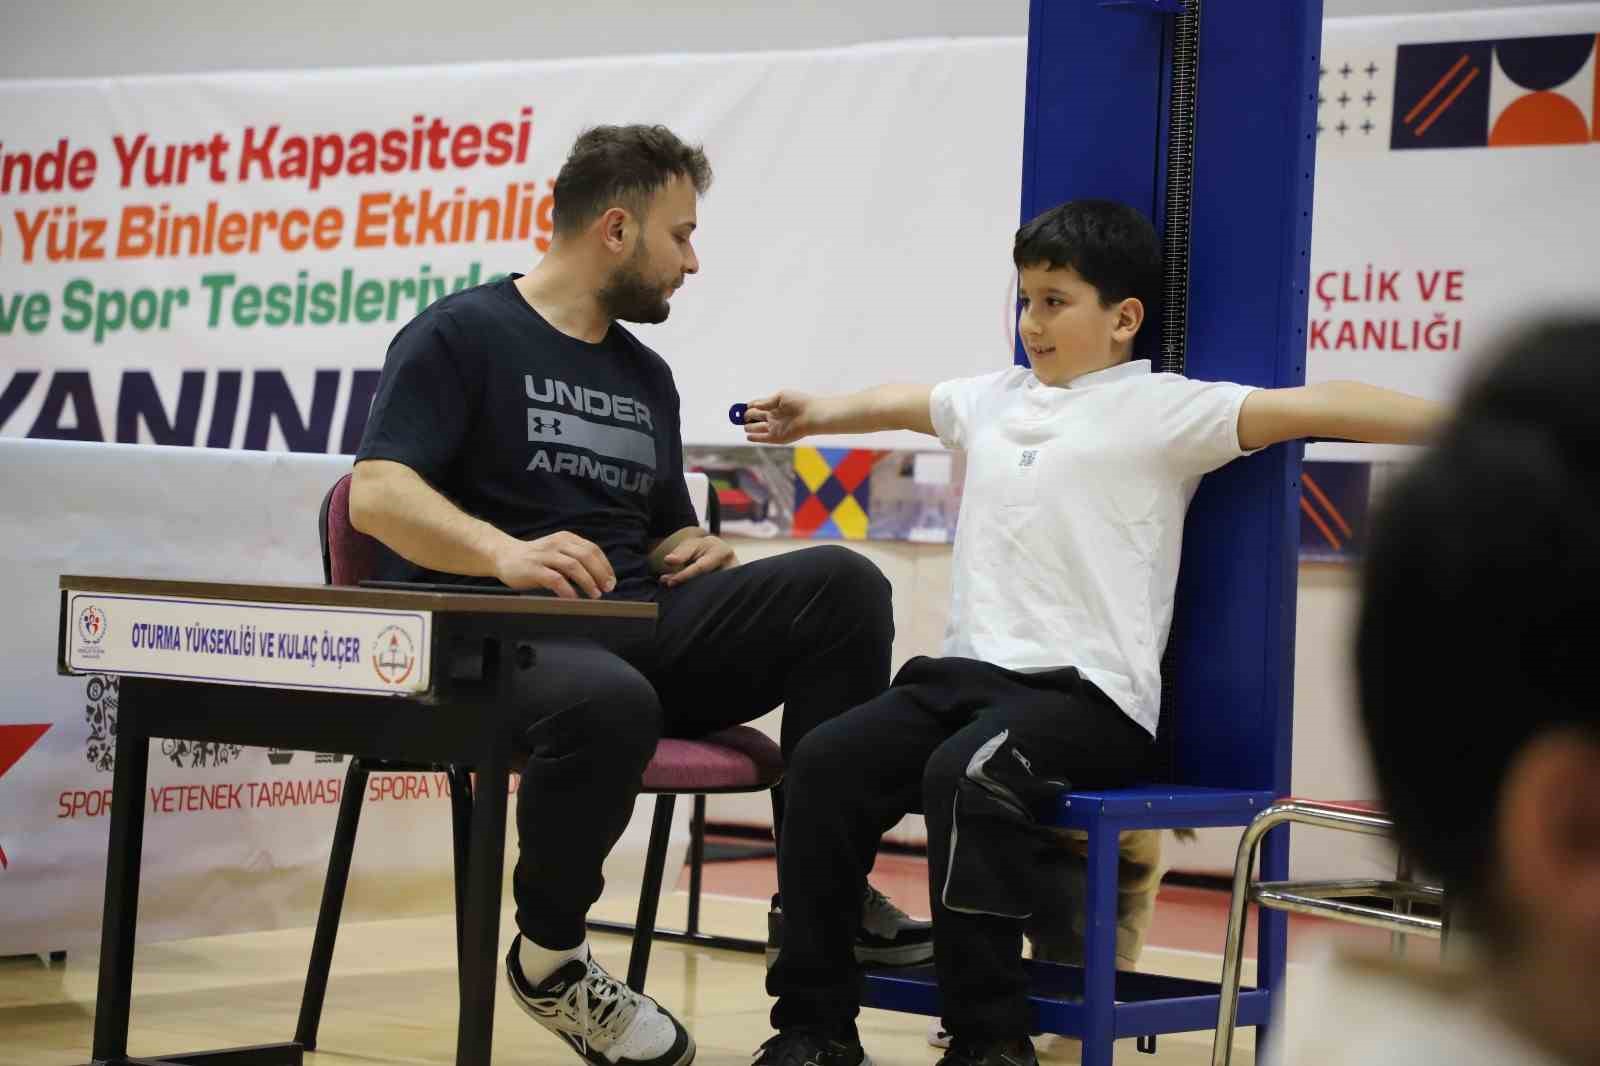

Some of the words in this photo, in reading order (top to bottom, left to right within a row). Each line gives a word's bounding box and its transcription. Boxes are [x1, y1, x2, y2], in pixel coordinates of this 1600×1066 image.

[0, 137, 97, 194] nde
[113, 134, 229, 188] Yurt
[239, 107, 533, 190] Kapasitesi
[15, 205, 108, 264] Yüz
[116, 203, 343, 259] Binlerce
[62, 277, 189, 344] Spor
[1315, 264, 1400, 311] ÇLİK
[1416, 270, 1465, 302] VE
[1310, 313, 1462, 351] KANLIĞI
[525, 374, 653, 431] UNDER
[132, 622, 181, 650] OTURMA
[186, 622, 257, 657] YÜKSEKLİĞİ
[259, 632, 275, 658] VE
[277, 632, 318, 667] KULAÇ
[321, 630, 361, 669] ÖLÇER
[150, 783, 241, 814] YETENEK
[248, 778, 342, 808] TARAMASI
[369, 774, 430, 802] SPORA
